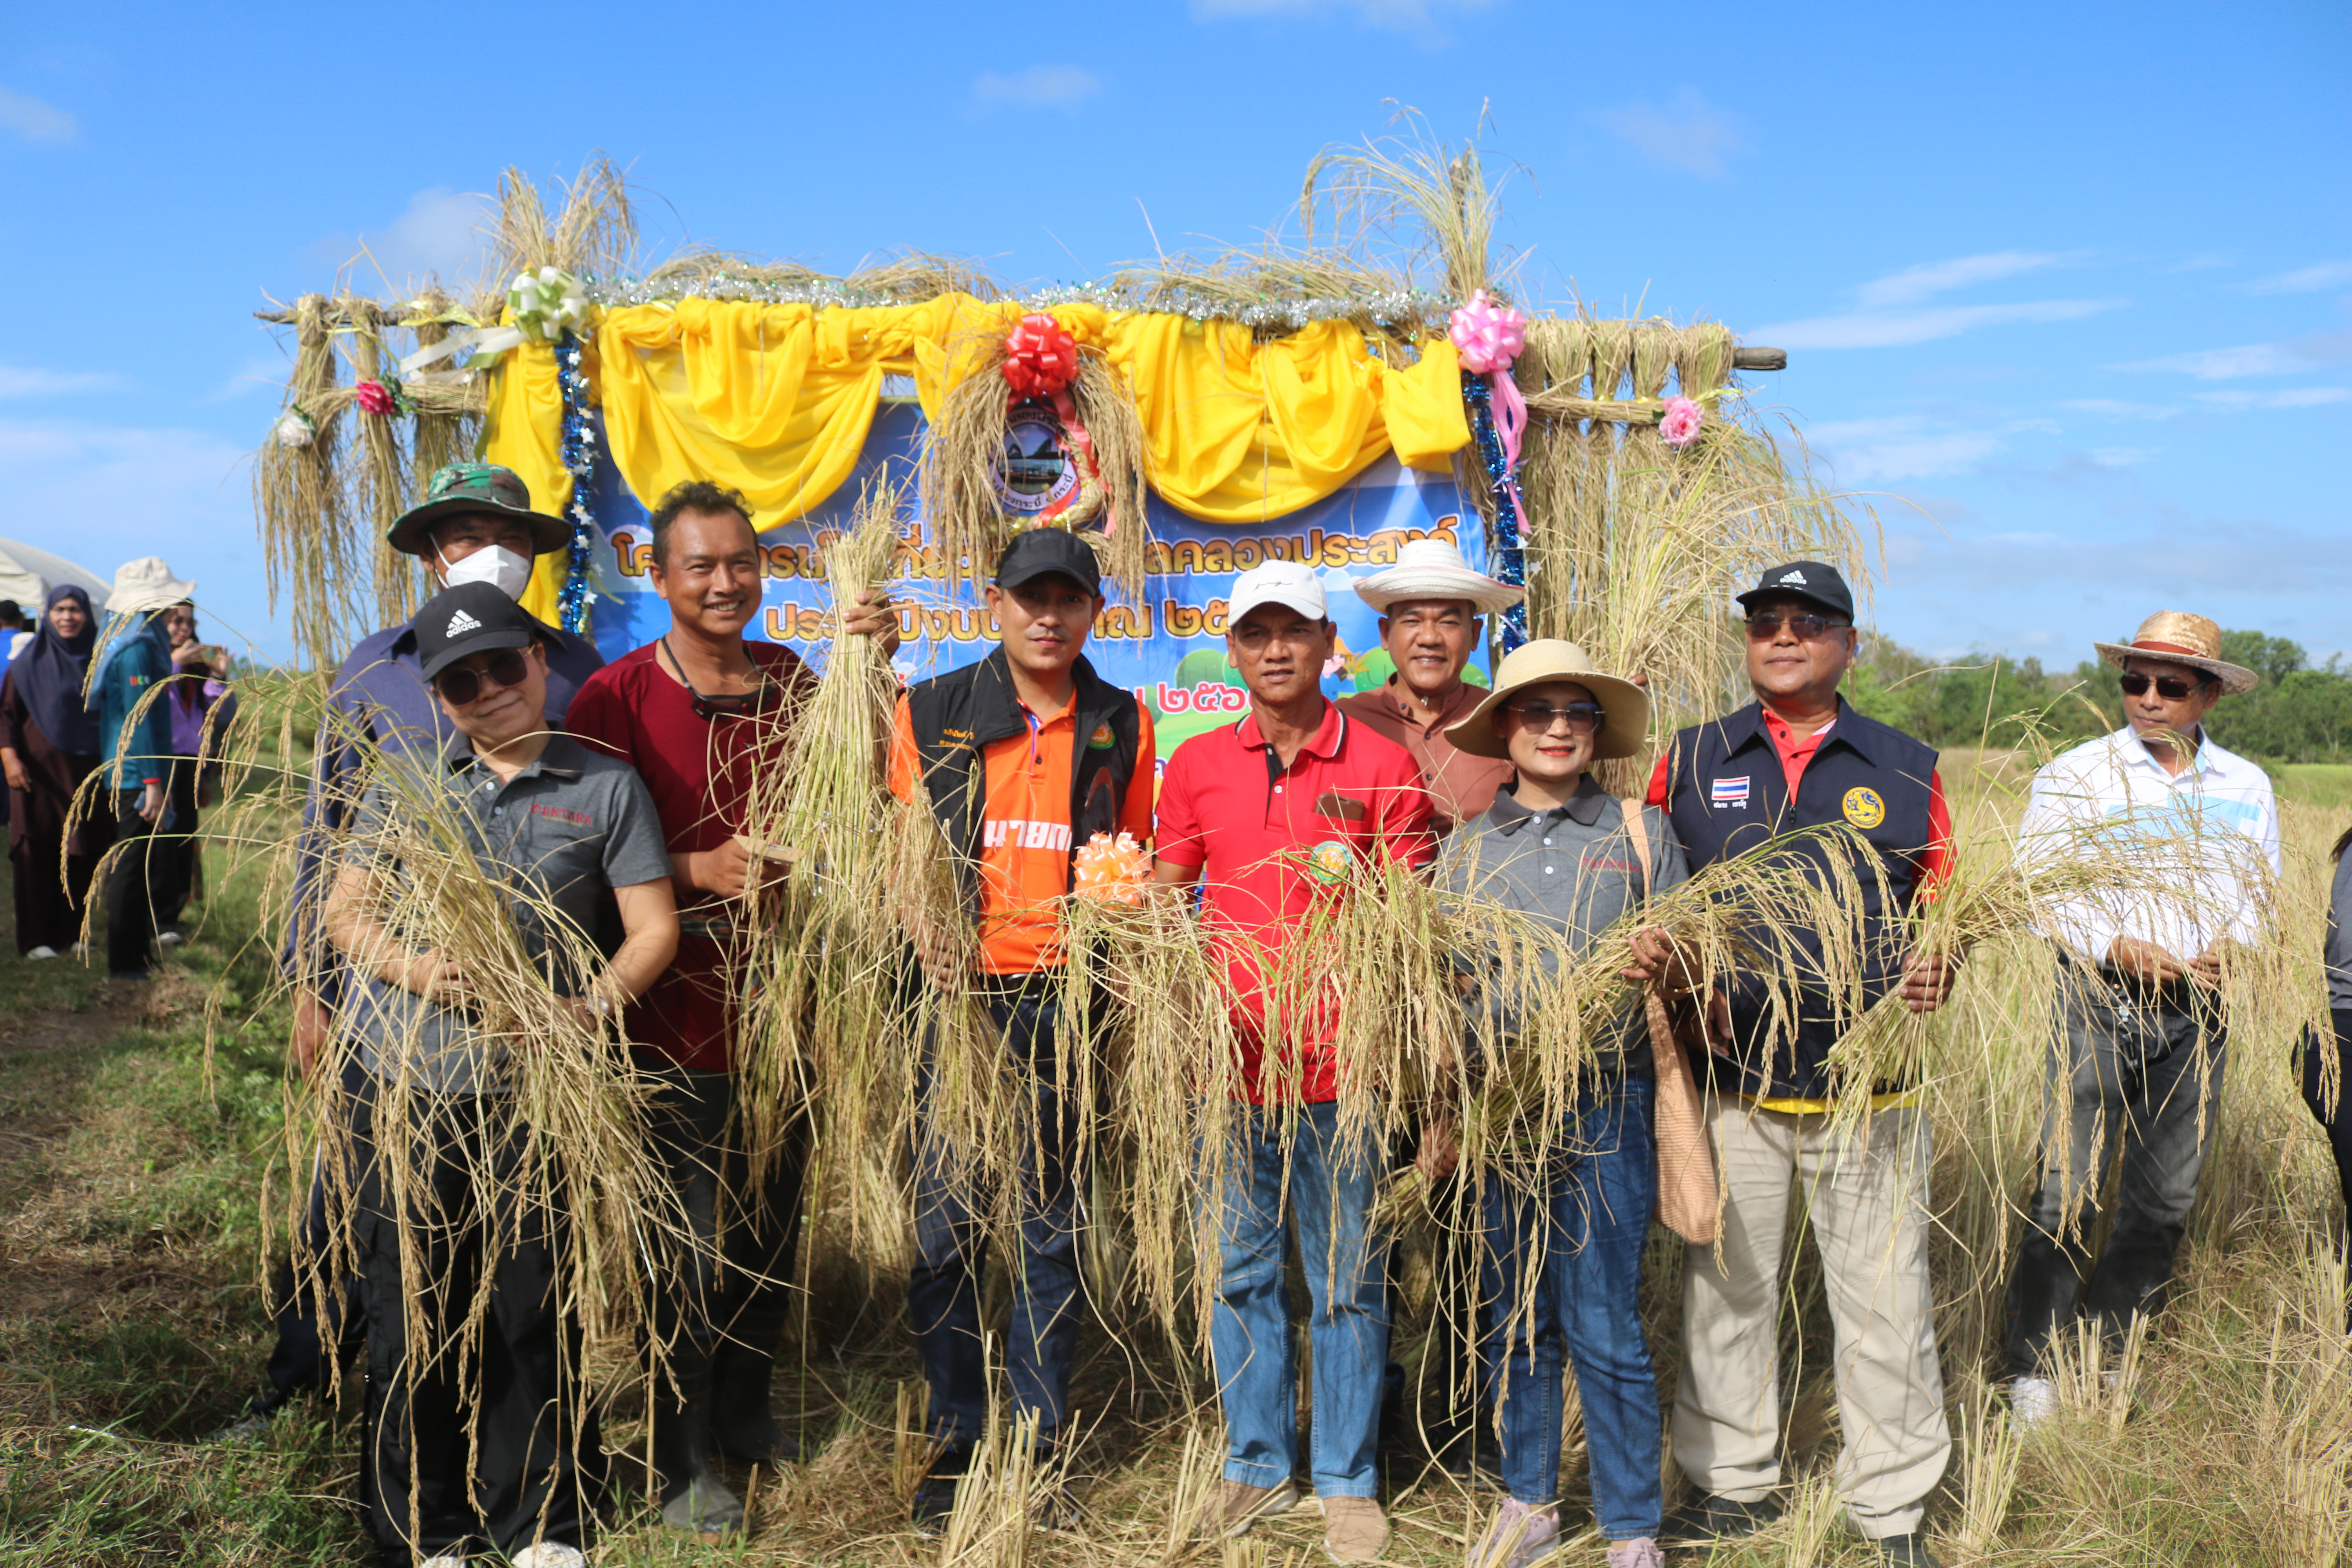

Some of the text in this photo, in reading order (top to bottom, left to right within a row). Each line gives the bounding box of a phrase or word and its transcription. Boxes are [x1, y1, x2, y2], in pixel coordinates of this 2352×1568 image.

[446, 619, 482, 638] adidas
[1158, 682, 1253, 713] ๒๕๖
[531, 803, 592, 824] CENTARA
[983, 820, 1073, 852] นายก
